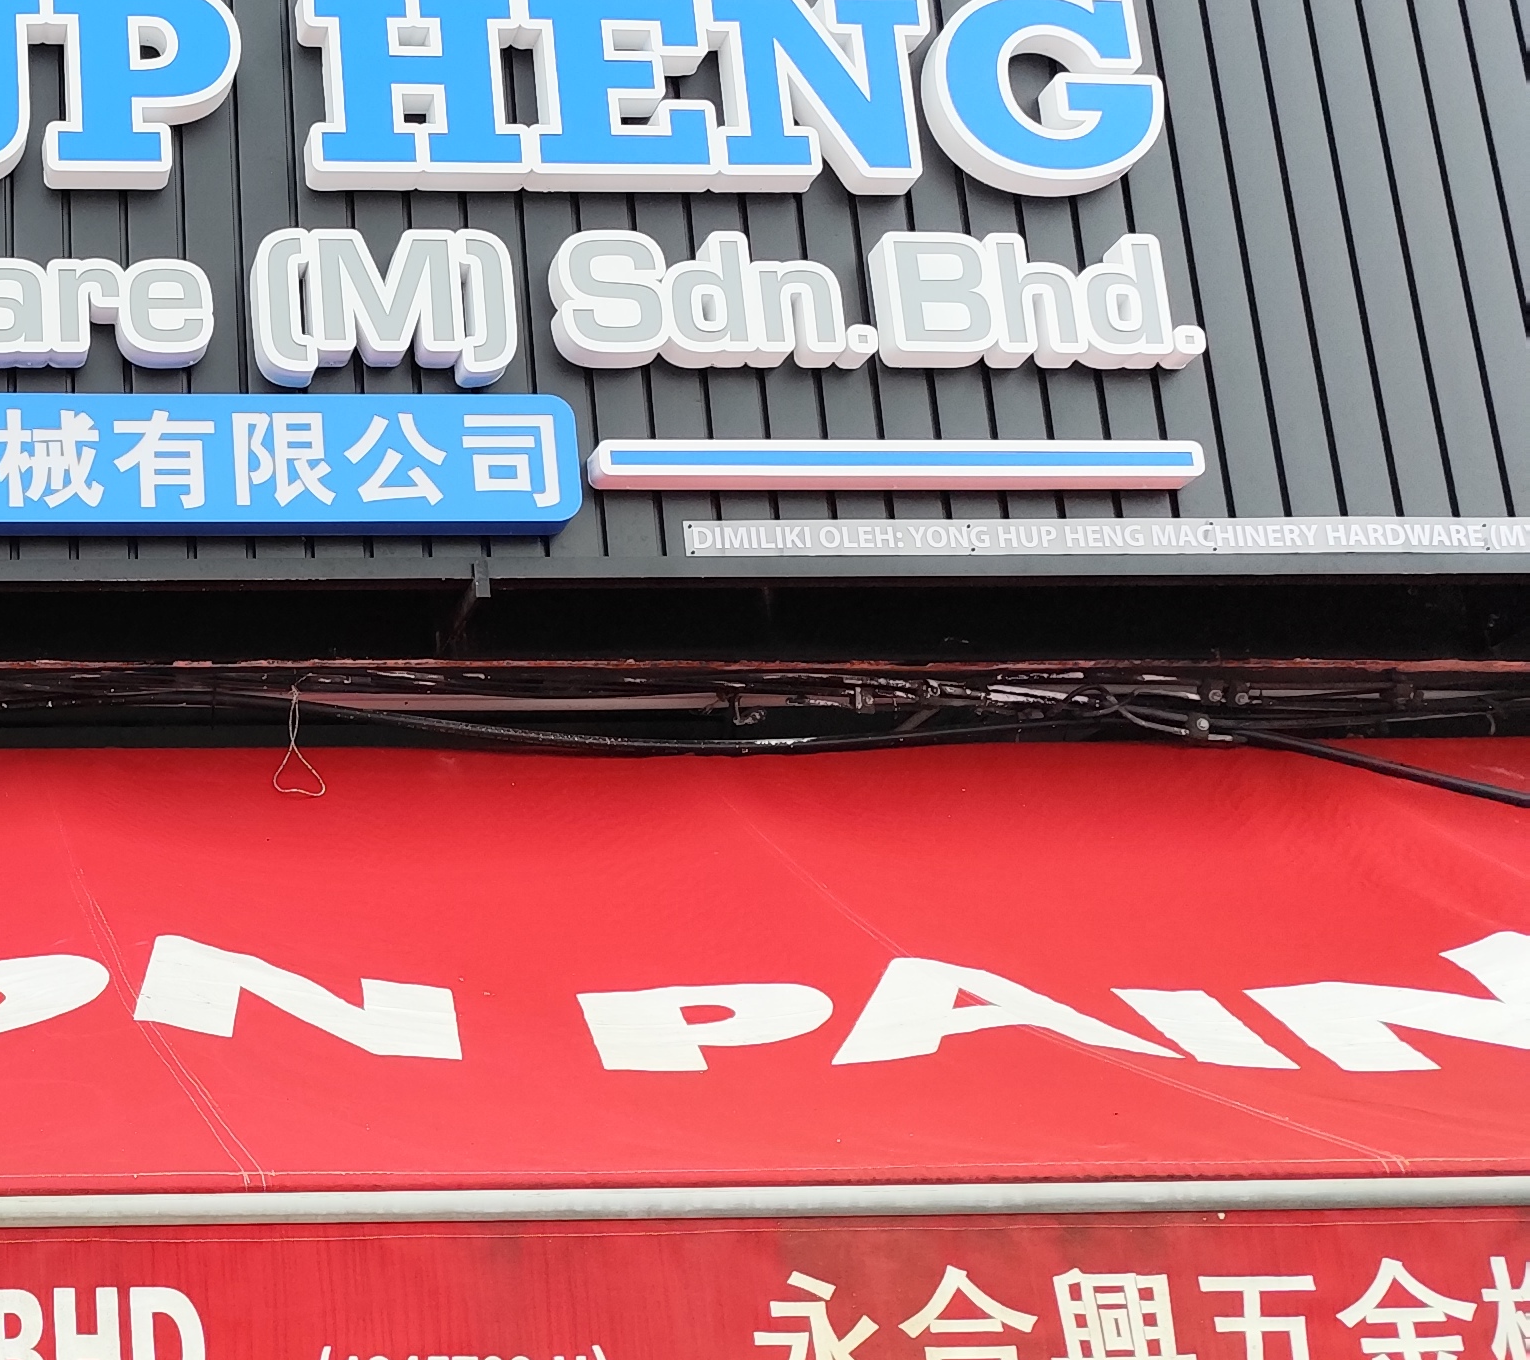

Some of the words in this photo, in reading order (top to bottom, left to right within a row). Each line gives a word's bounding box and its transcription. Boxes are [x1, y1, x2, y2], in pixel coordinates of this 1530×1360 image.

[250, 227, 517, 388] (M)
[548, 229, 878, 369] Sdn.
[869, 230, 1205, 370] Bhd.
[692, 526, 812, 549] DIMILIKI
[819, 526, 903, 548] OLEH:
[906, 526, 991, 548] YONG
[999, 526, 1057, 548] HUP
[1065, 525, 1143, 547] HENG
[1152, 525, 1317, 547] MACHINERY
[1326, 524, 1485, 547] HARDWARE
[576, 931, 1530, 1073] PAIN
